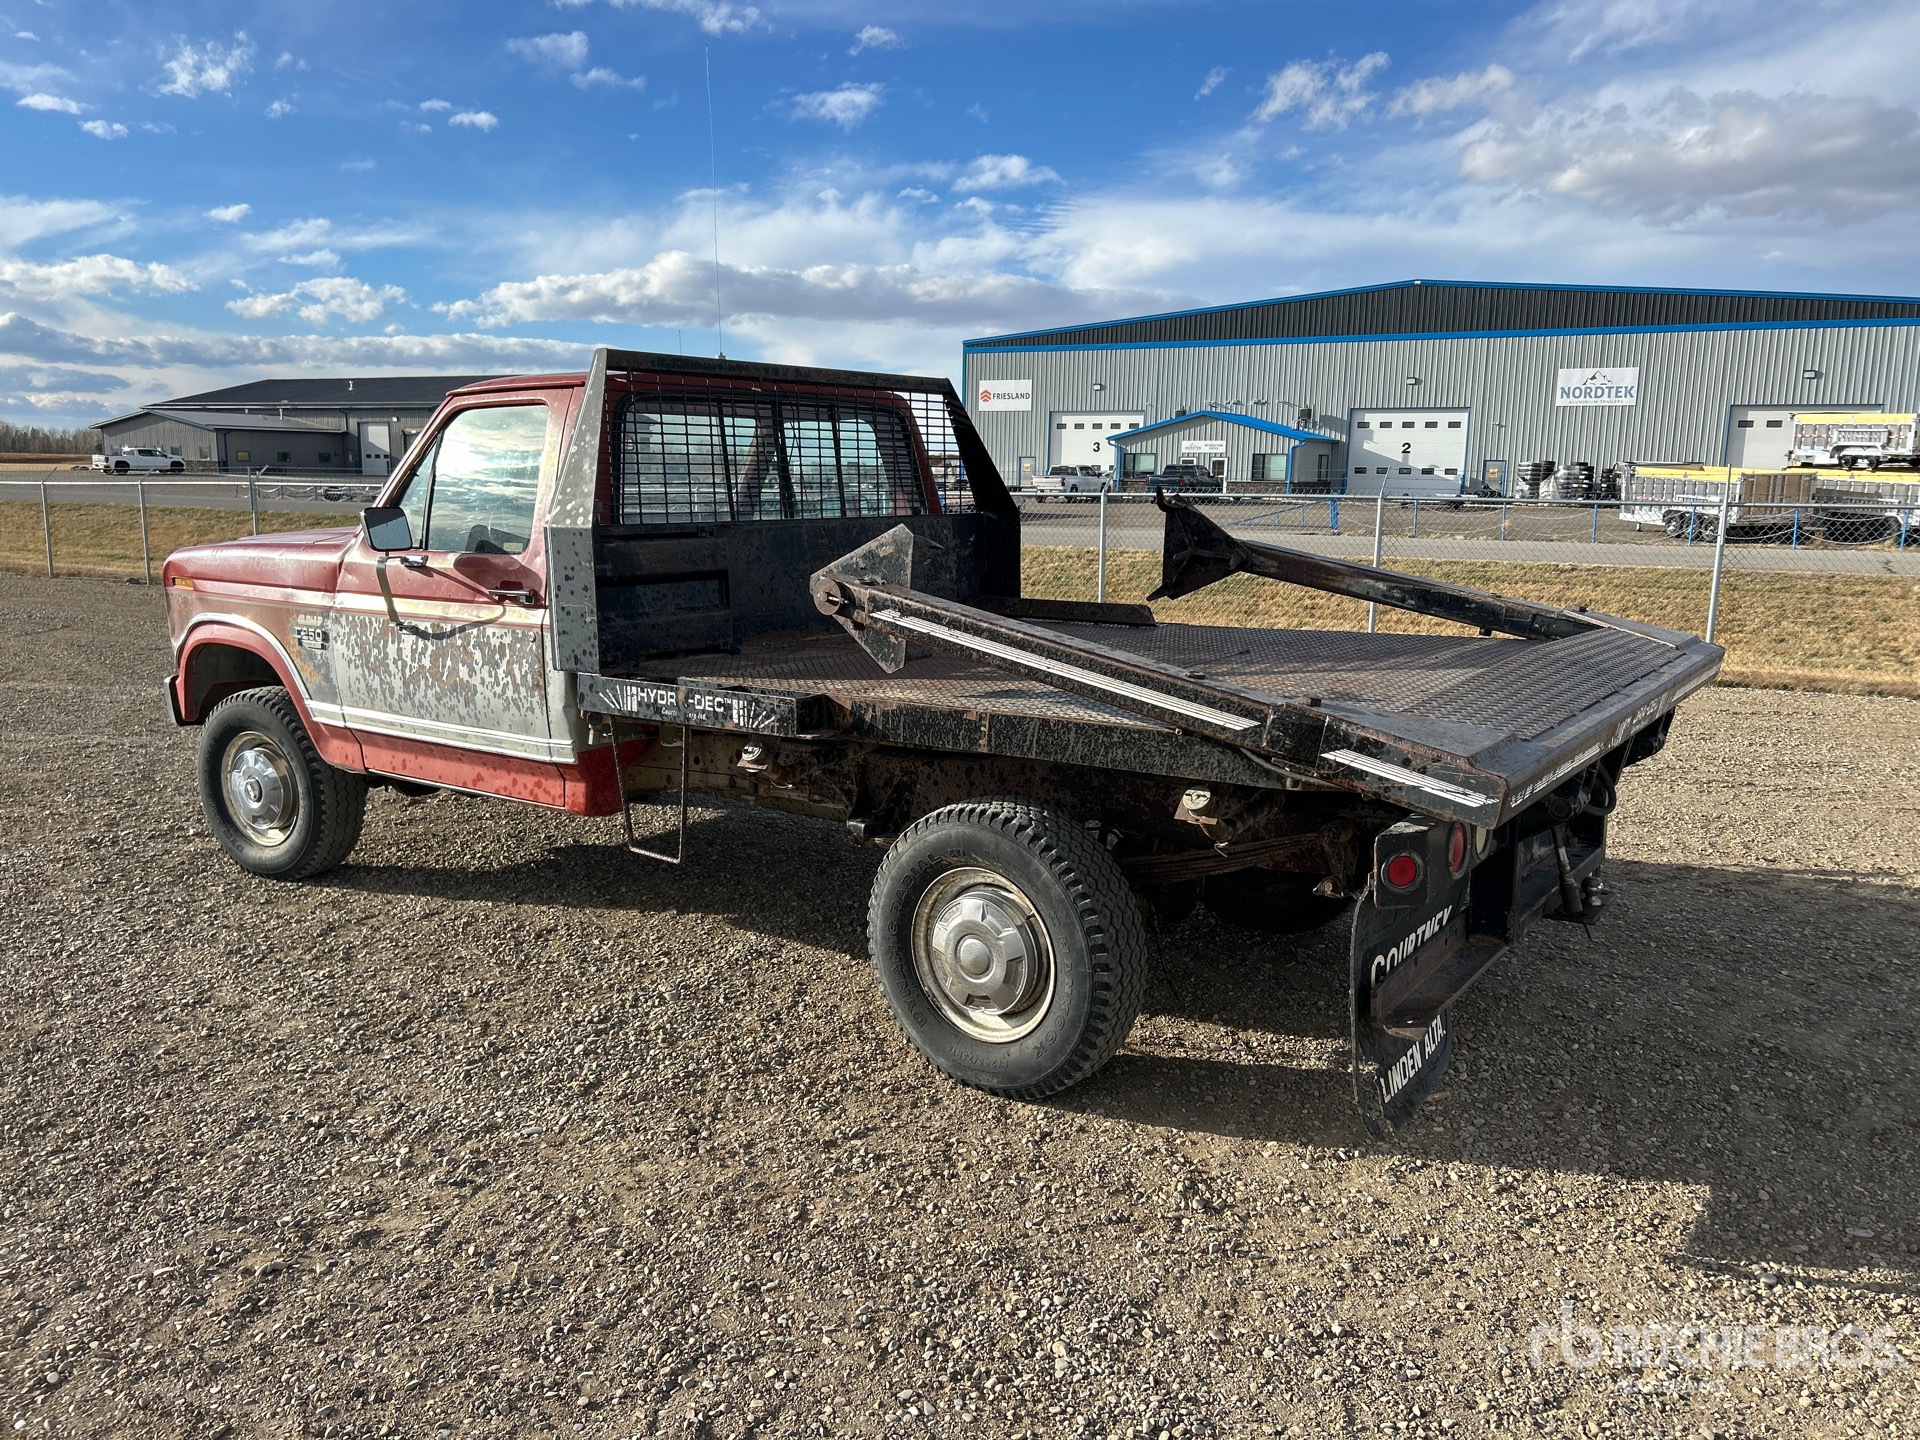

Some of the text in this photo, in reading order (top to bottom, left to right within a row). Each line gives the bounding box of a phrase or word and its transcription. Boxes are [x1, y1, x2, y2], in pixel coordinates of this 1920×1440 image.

[992, 392, 1031, 400] FRIESLAND
[1560, 386, 1635, 399] NORDTEK
[1092, 441, 1101, 453] 3
[1401, 442, 1412, 454] 2
[890, 853, 943, 915] RADIAL
[1033, 935, 1073, 1059] HANKOOK
[1380, 1014, 1447, 1104] LINDEN ALTA.
